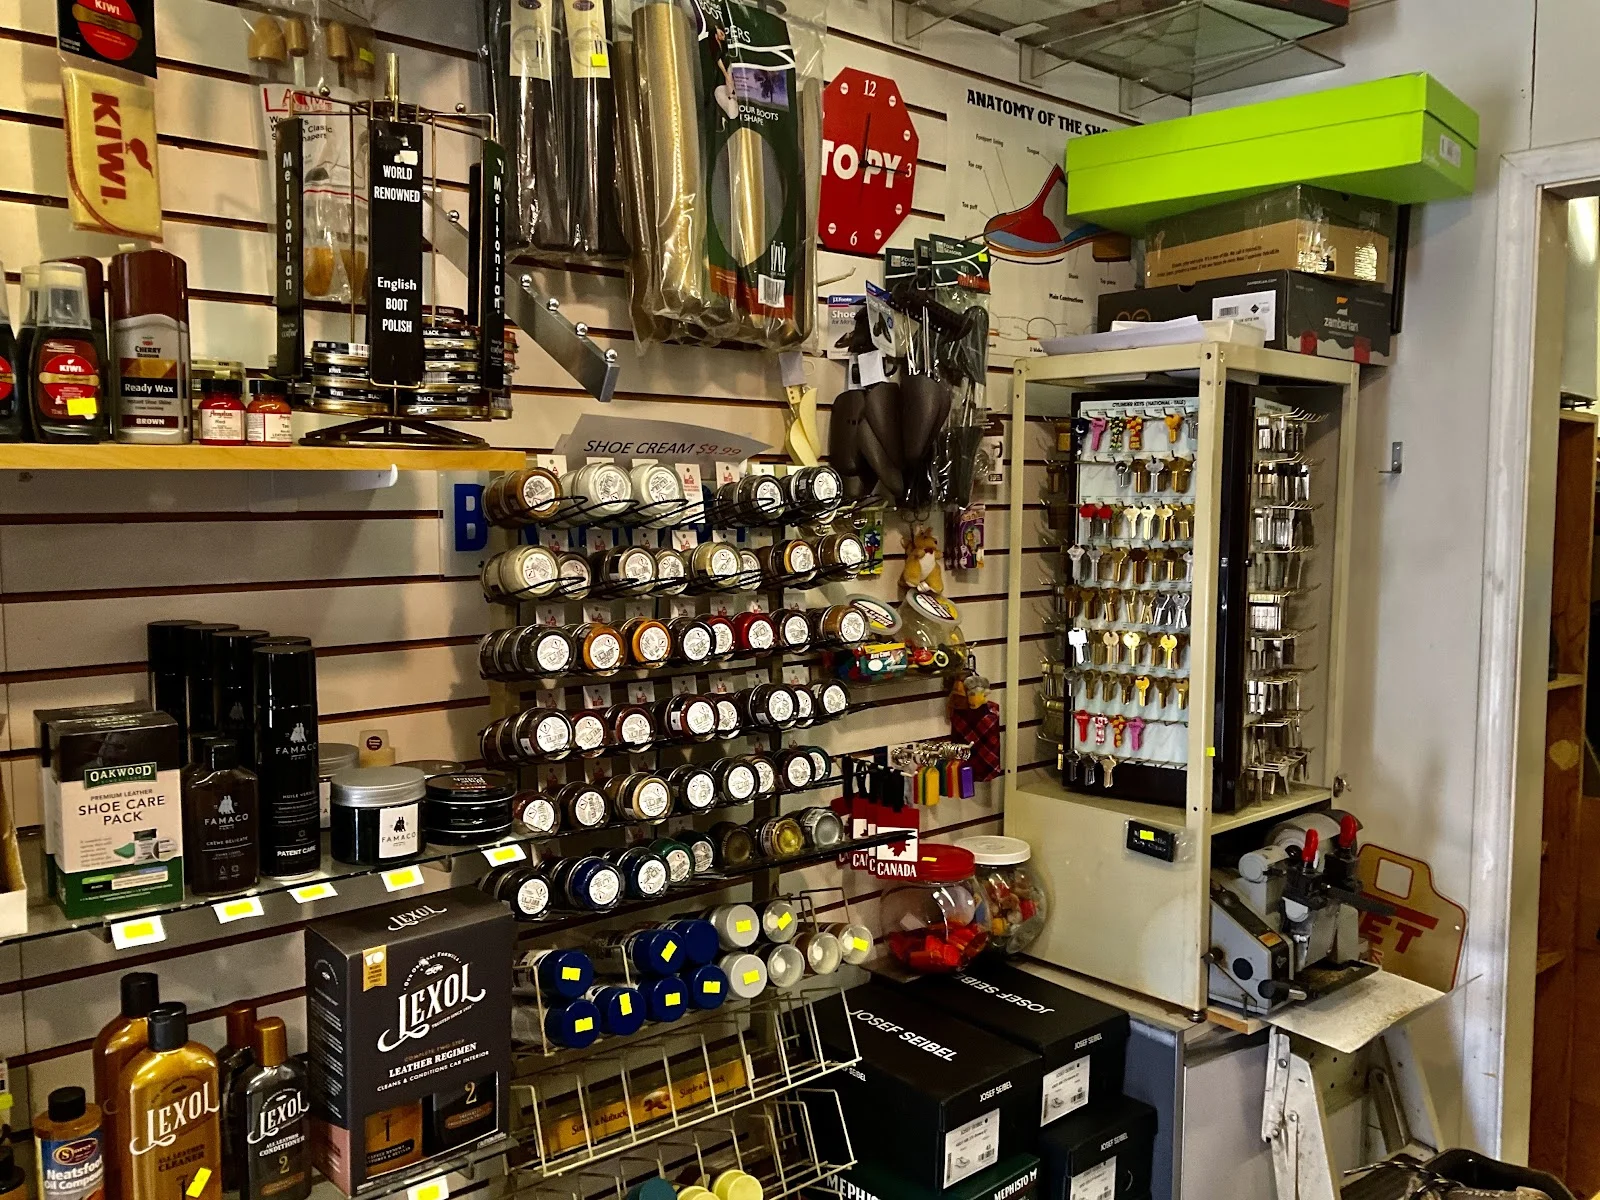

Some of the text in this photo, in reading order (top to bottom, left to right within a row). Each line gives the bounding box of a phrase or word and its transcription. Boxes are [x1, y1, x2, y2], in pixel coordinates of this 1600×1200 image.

[95, 0, 121, 15] KIWI
[863, 79, 877, 98] 12
[744, 113, 763, 125] SHAPE
[756, 109, 779, 121] BOOTS
[967, 89, 1035, 121] ANATOMY
[1037, 110, 1055, 127] OF
[1058, 116, 1082, 135] THE
[92, 92, 126, 200] KIWI
[383, 165, 412, 180] WORLD
[905, 163, 912, 177] 3
[374, 186, 420, 202] RENOWNED
[283, 152, 292, 291] Meltonian
[850, 231, 858, 246] 6
[377, 276, 417, 292] English
[385, 298, 408, 311] BOOT
[832, 310, 856, 318] Shoe
[382, 319, 413, 333] POLISH
[1324, 317, 1359, 332] zamberlan
[59, 364, 82, 372] KIWI
[125, 383, 174, 394] Ready Wax
[136, 417, 165, 425] BROWN
[584, 440, 742, 456] SHOE CREAM $9.99
[275, 741, 317, 754] FAMACO
[90, 765, 152, 782] OAKWOOD
[90, 789, 153, 801] PREMIUM LEATHER
[78, 796, 166, 816] SHOE CARE
[103, 812, 143, 826] PACK
[204, 813, 249, 825] FAMACO
[382, 832, 416, 843] FAMACO
[277, 845, 316, 857] PATENT CARE
[877, 862, 917, 877] CANADA
[388, 905, 447, 931] LEXOL
[953, 972, 1055, 1014] JOSEF SEIBE
[377, 963, 486, 1053] LEXOL
[848, 1009, 957, 1061] JOSEF SEIBEL
[1074, 1033, 1102, 1050] JOSEF SEIBEL
[389, 1042, 477, 1078] LEATHER REGIMEN
[377, 1080, 401, 1092] CLEANS
[409, 1064, 448, 1081] CONDITIONS
[450, 1060, 461, 1068] CAR
[463, 1050, 489, 1063] INTERIOR
[465, 1081, 477, 1104] 2
[980, 1081, 1012, 1102] JOSEF SEIBEL
[129, 1081, 220, 1155] LEXOL
[247, 1091, 310, 1144] LEXOL
[259, 1135, 305, 1157] CONDITIONER
[1100, 1132, 1128, 1151] JOSEF SEIBEL
[158, 1151, 205, 1173] CLEANER
[279, 1156, 289, 1174] 2
[45, 1180, 56, 1190] Oil
[994, 1174, 1029, 1200] MEPHISTO
